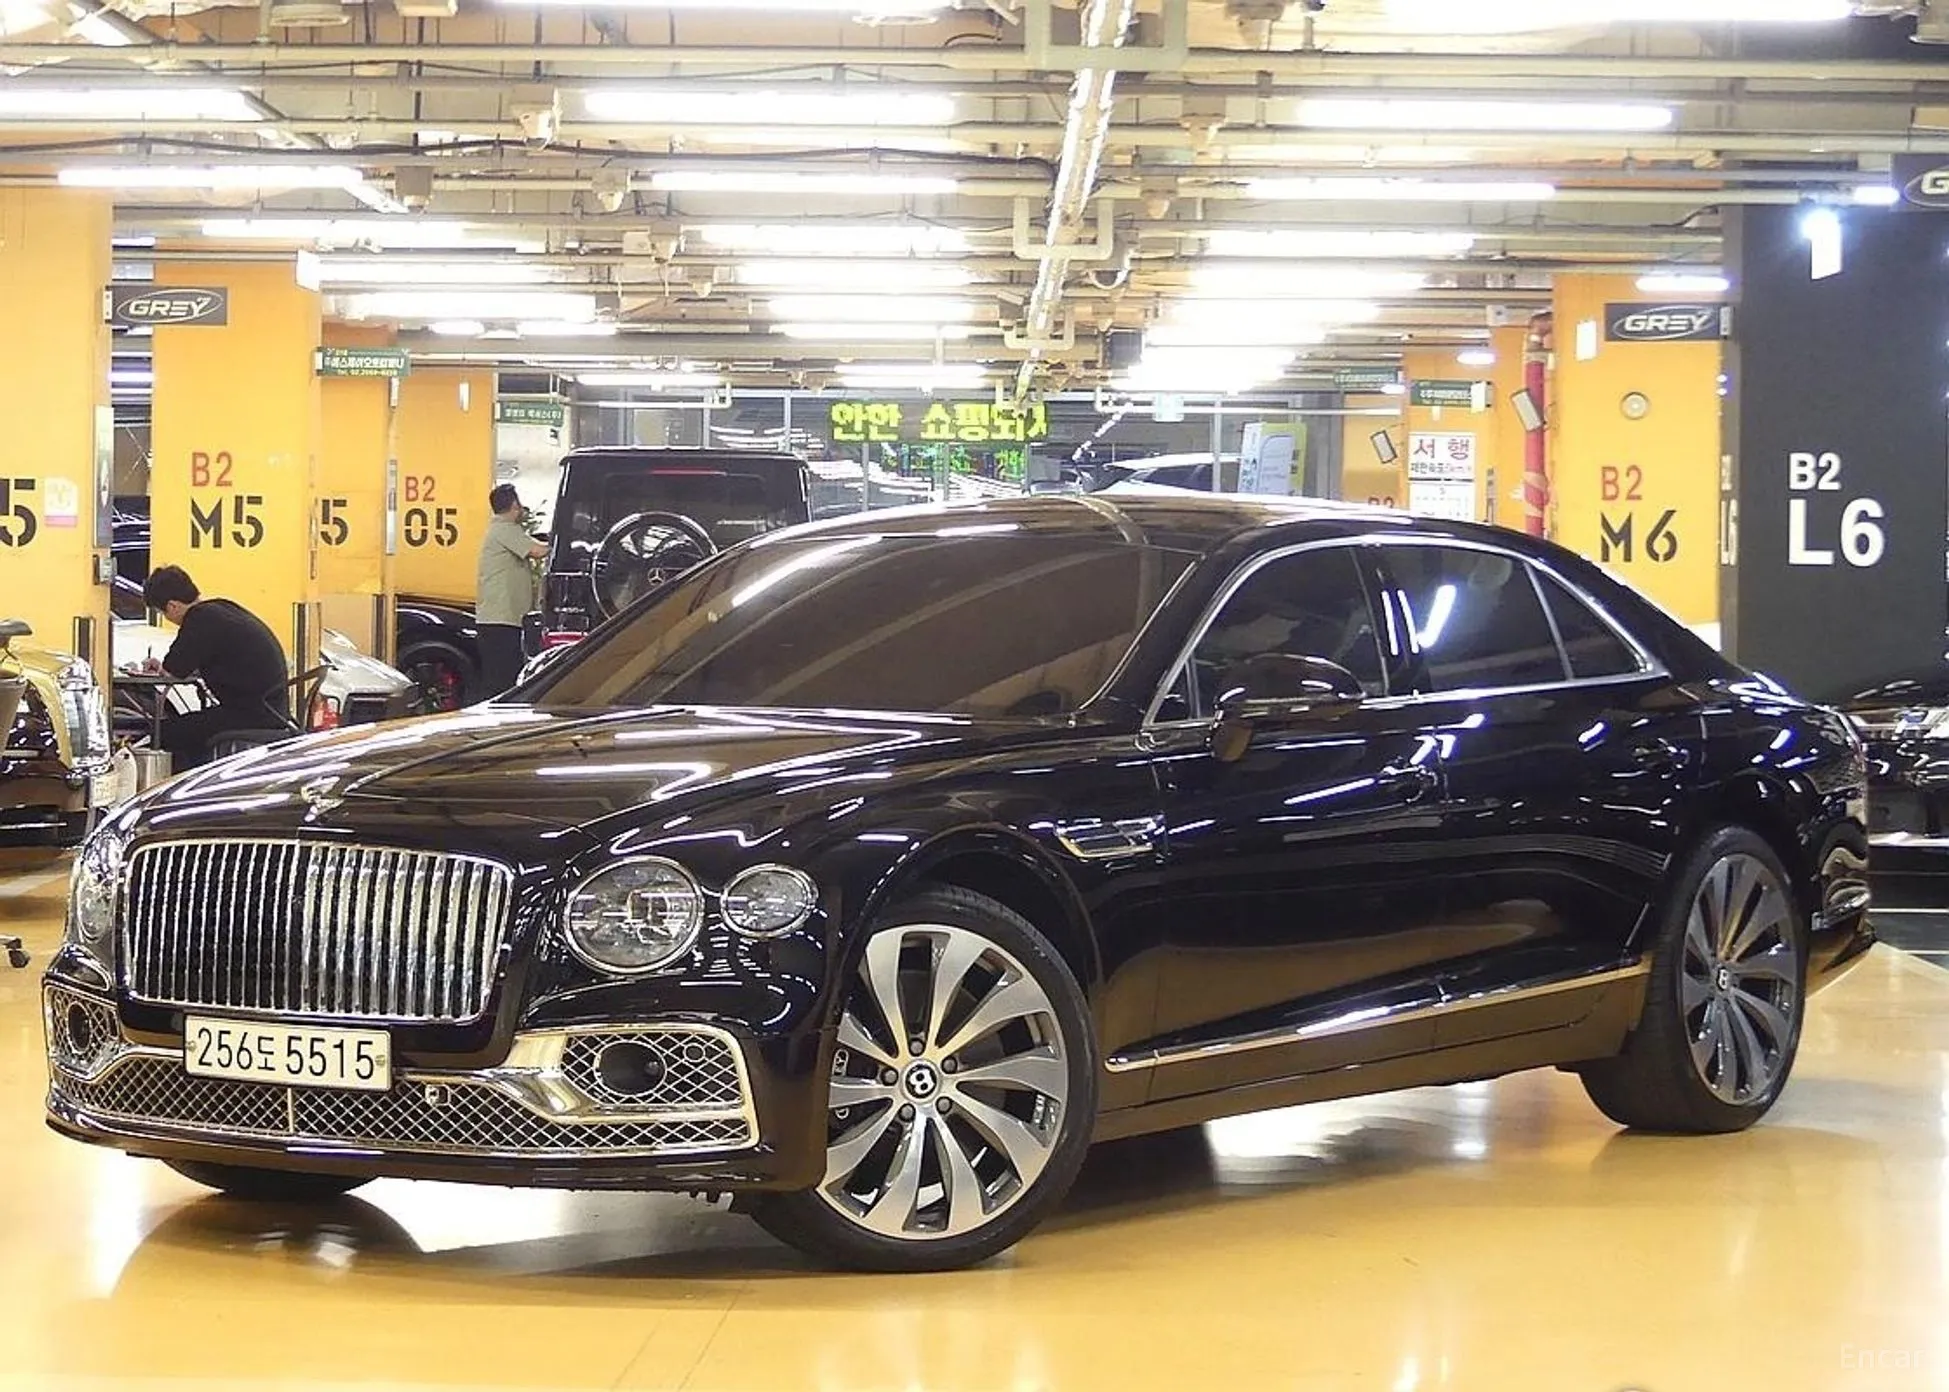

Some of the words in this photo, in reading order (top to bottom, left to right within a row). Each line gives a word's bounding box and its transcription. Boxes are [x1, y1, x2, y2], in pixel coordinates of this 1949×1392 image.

[129, 297, 212, 317] GREY
[1625, 312, 1711, 333] GREY
[192, 452, 233, 487] B2
[1601, 466, 1643, 500] B2
[1788, 452, 1841, 490] B2
[406, 476, 435, 501] B2
[190, 496, 264, 548] M5
[1600, 509, 1678, 562] M6
[1789, 498, 1885, 566] L6
[198, 1027, 276, 1071] 256도
[286, 1035, 374, 1080] 5515
